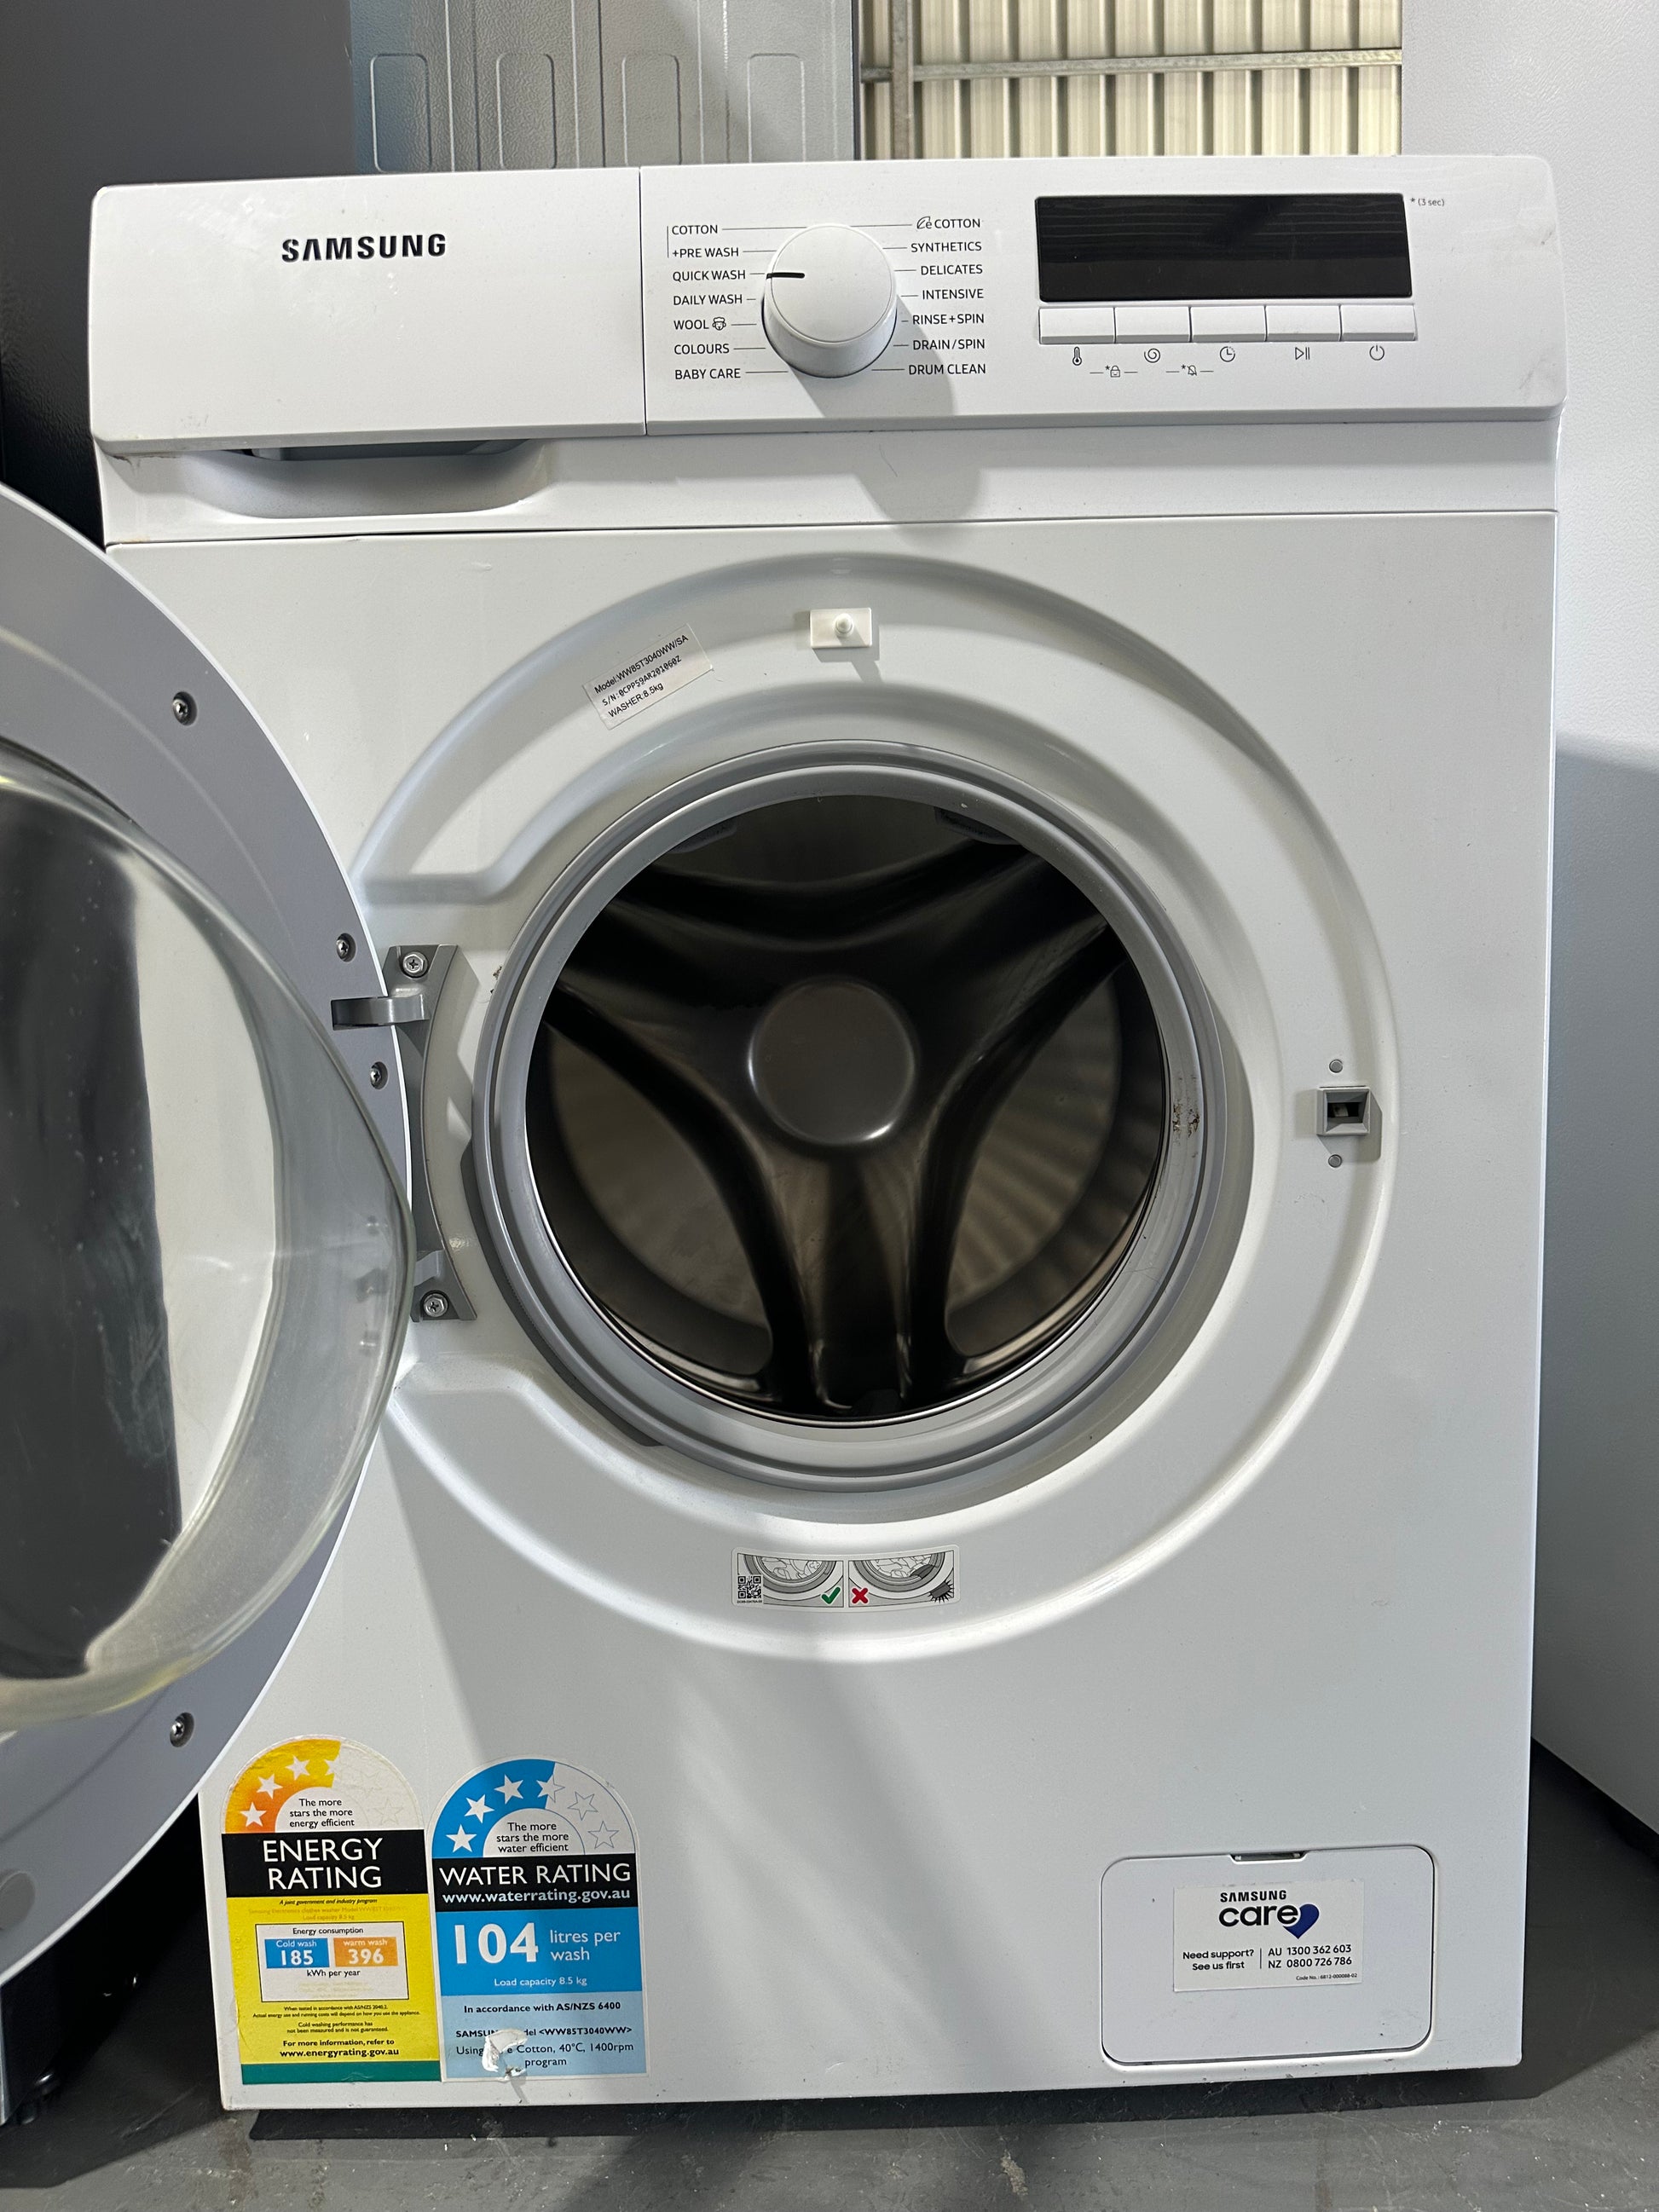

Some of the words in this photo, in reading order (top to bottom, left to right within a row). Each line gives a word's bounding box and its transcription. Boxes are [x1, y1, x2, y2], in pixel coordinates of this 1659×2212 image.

[1428, 199, 1445, 207] sec)
[934, 218, 980, 228] COTTON
[672, 225, 718, 236] COTTON
[282, 234, 446, 263] SAMSUNG
[673, 247, 702, 258] +PRE
[704, 246, 739, 257] WASH
[910, 241, 982, 252] SYNTHETICS
[673, 270, 708, 281] QUICK
[711, 269, 746, 280] WASH
[921, 264, 983, 275] DELICATES
[673, 295, 706, 305] DAILY
[708, 294, 743, 304] WASH
[922, 288, 984, 300] INTENSIVE
[673, 320, 709, 331] WOOL
[674, 344, 730, 355] COLOURS
[674, 369, 708, 379] BABY
[709, 368, 741, 378] CARE
[909, 365, 945, 375] DRUM
[947, 363, 986, 375] CLEAN
[507, 1822, 528, 1831] The
[263, 1838, 383, 1863] ENERGY
[268, 1866, 382, 1890] RATING
[439, 1866, 528, 1886] WATER
[536, 1863, 631, 1884] RATING
[442, 1888, 630, 1903] www.waterrating.gov.au
[1220, 1890, 1286, 1903] SAMSUNG
[1218, 1904, 1298, 1927] care
[292, 1927, 316, 1936] Energy
[319, 1927, 363, 1936] consumption
[298, 1939, 317, 1948] wash
[454, 1922, 539, 1964] 104
[550, 1930, 588, 1943] litres
[594, 1931, 621, 1946] per
[550, 1947, 590, 1961] wash
[1182, 1951, 1209, 1960] Need
[1211, 1949, 1254, 1960] support?
[1268, 1948, 1282, 1956] AU
[1286, 1946, 1310, 1955] 1300
[1313, 1945, 1331, 1955] 362
[1332, 1944, 1351, 1953] 603
[280, 1949, 314, 1966] 185
[348, 1949, 384, 1964] 396
[1268, 1960, 1281, 1968] NZ
[1286, 1958, 1313, 1967] 0800
[1315, 1957, 1332, 1967] 726
[1334, 1956, 1352, 1965] 786
[1226, 1961, 1245, 1969] first
[328, 1970, 342, 1978] per
[494, 1978, 517, 1987] Load
[519, 1977, 557, 1988] capacity
[559, 1977, 573, 1985] 8.5
[576, 1976, 587, 1986] kg
[464, 2005, 474, 2013] In
[476, 2004, 530, 2013] accordance
[533, 2003, 554, 2013] with
[556, 2002, 595, 2012] AS/NZS
[598, 2001, 621, 2010] 6400
[539, 2026, 632, 2036] <WW85T3040WW>
[320, 2039, 366, 2047] information,
[456, 2046, 483, 2056] Using
[516, 2044, 555, 2053] Cotton,
[590, 2042, 633, 2054] 1400rpm
[280, 2047, 399, 2058] www.energyrating.gov.au
[524, 2058, 567, 2069] program
